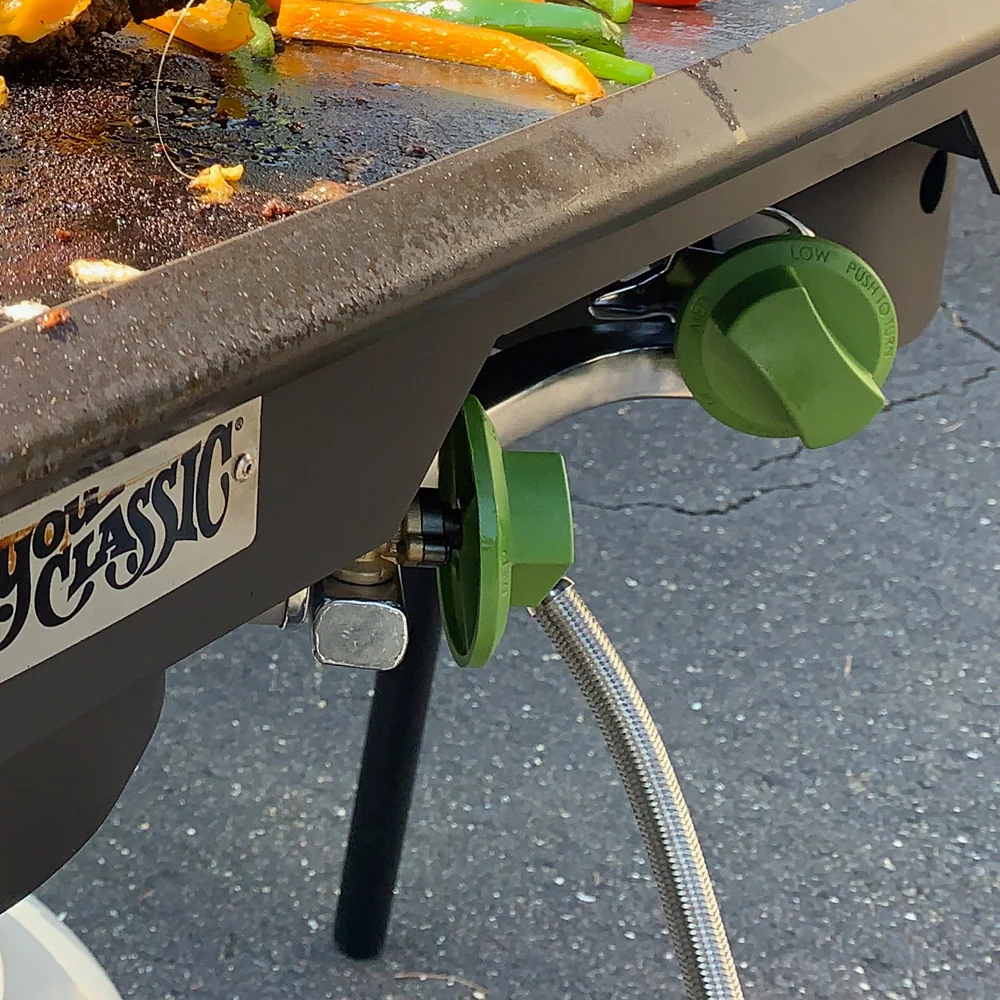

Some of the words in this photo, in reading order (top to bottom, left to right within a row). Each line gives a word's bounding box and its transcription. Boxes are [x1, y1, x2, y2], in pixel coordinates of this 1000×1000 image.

[791, 246, 830, 263] LOW
[846, 261, 880, 295] PUSH
[876, 294, 891, 316] TO
[884, 318, 896, 358] TURN
